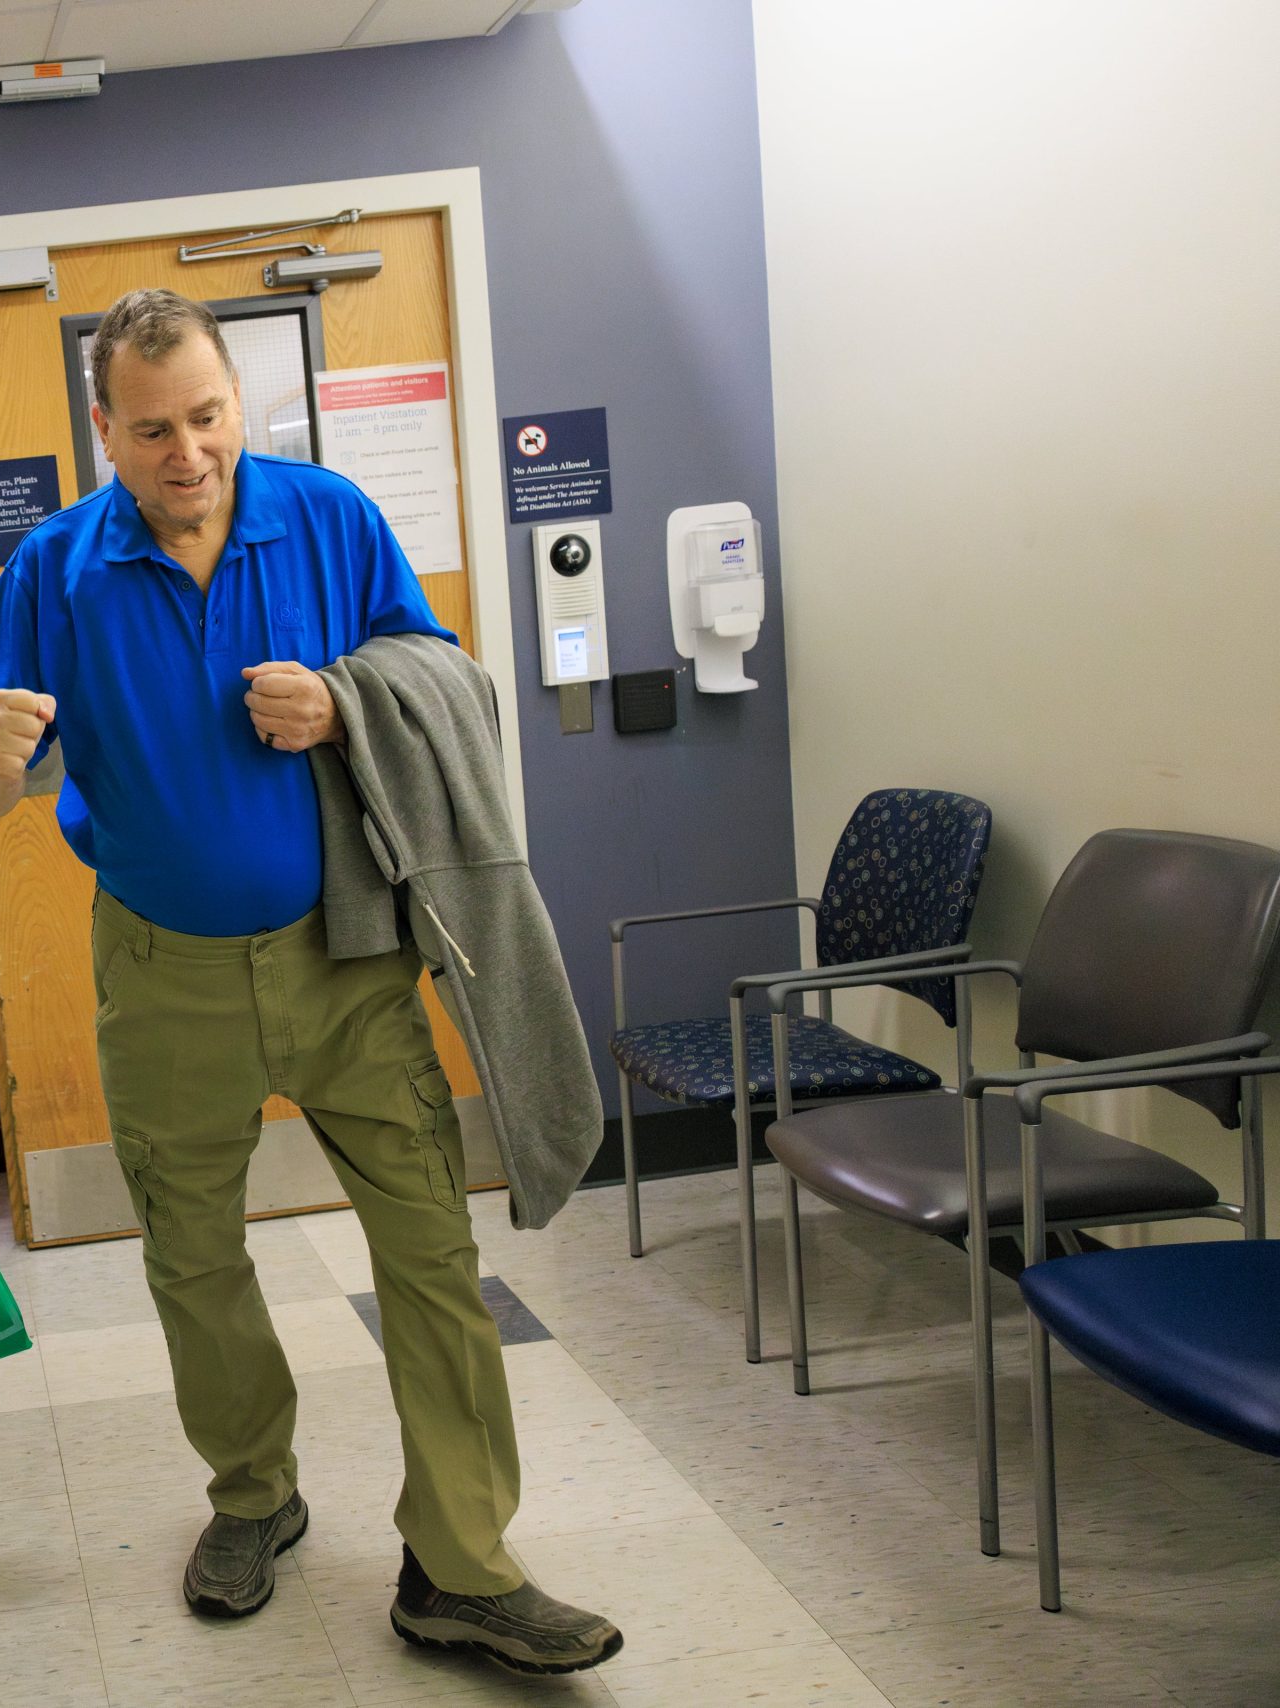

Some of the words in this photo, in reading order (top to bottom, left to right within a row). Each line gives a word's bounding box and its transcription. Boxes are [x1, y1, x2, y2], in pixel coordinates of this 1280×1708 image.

[330, 383, 361, 393] Attention
[361, 380, 389, 391] patients
[390, 378, 403, 387] and
[404, 376, 429, 385] visitors
[333, 412, 377, 426] Inpatient
[379, 407, 427, 420] Visitation
[335, 428, 343, 438] 11
[345, 428, 361, 437] am
[373, 424, 380, 433] 8
[382, 424, 399, 435] pm
[400, 420, 422, 432] only
[513, 467, 525, 476] No
[526, 463, 558, 475] Animals
[560, 459, 590, 471] Allowed
[14, 476, 38, 485] Plants
[549, 482, 570, 490] Service
[570, 478, 594, 488] Animals
[1, 487, 21, 496] Fruit
[22, 486, 30, 494] in
[516, 495, 538, 503] defined
[569, 488, 599, 497] Americans
[0, 499, 26, 507] Rooms
[19, 505, 44, 514] Under
[529, 501, 561, 511] Disabilities
[572, 497, 592, 506] (ADA)
[22, 516, 30, 525] in
[31, 514, 48, 523] Uni
